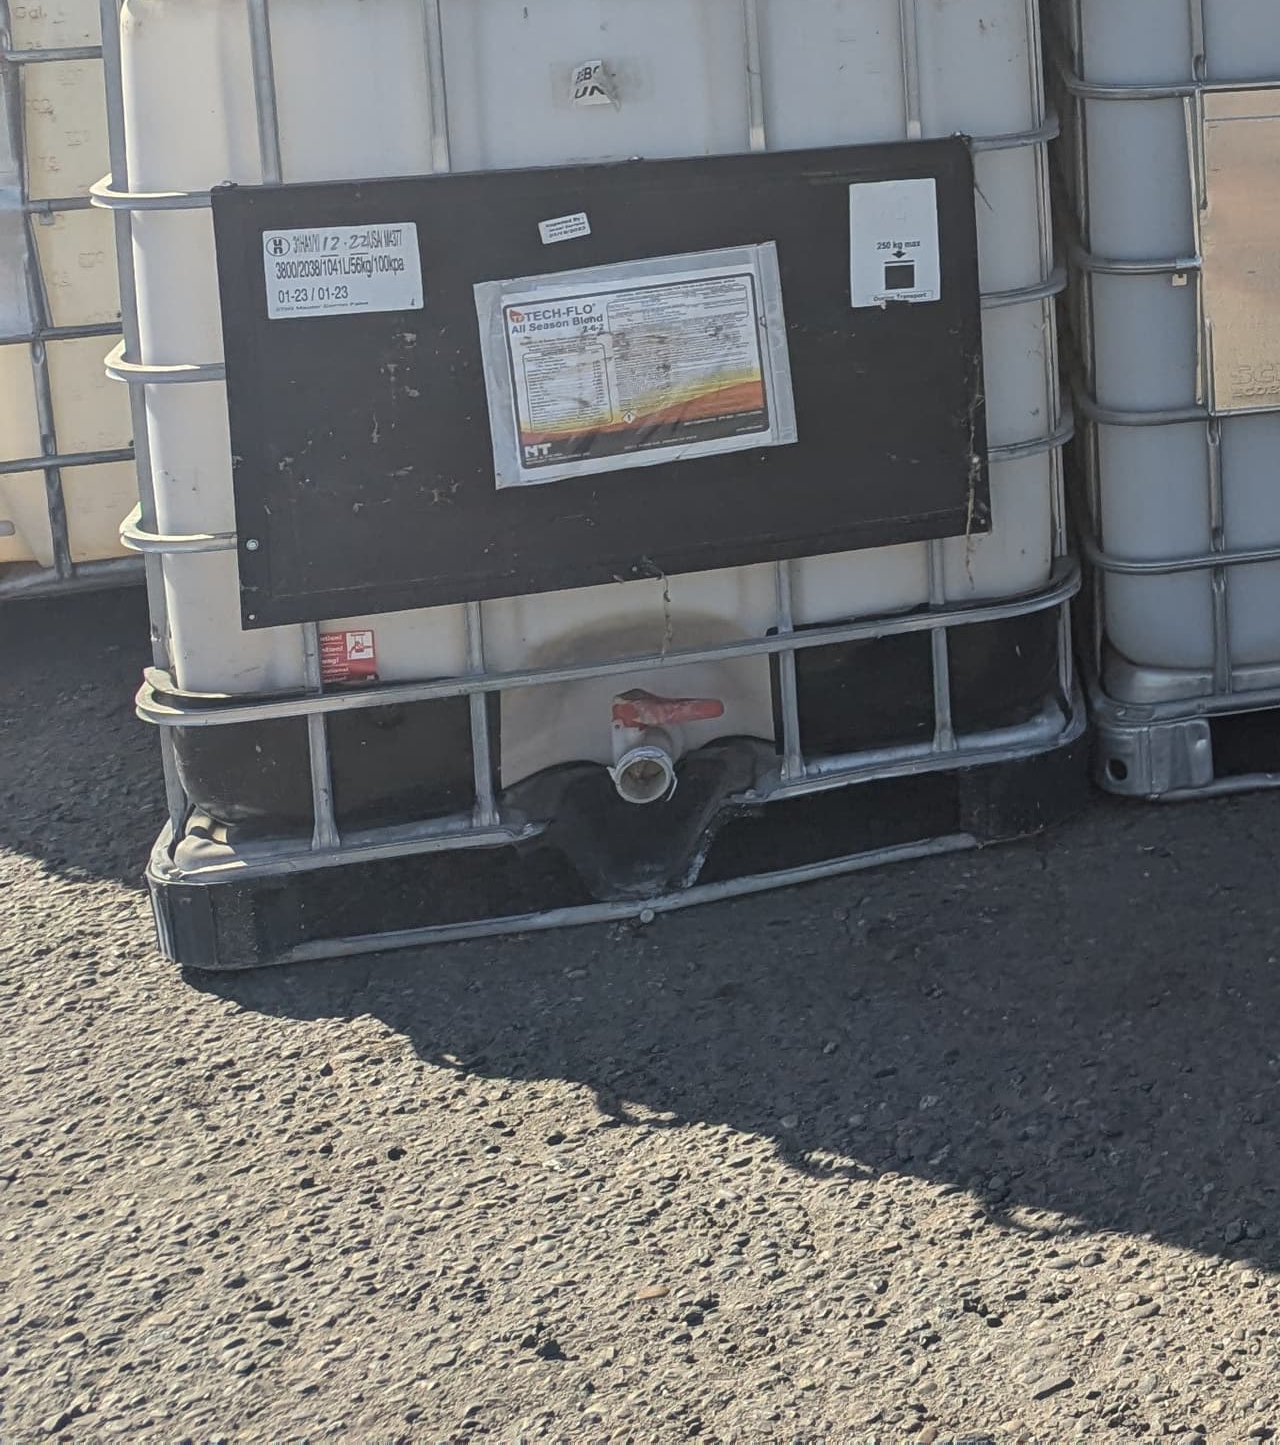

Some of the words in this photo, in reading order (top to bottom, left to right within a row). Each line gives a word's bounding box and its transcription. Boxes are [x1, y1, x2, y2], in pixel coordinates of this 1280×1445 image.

[876, 241, 892, 250] 250
[893, 240, 903, 249] kg
[904, 240, 921, 248] max
[278, 288, 308, 303] 01-23
[318, 286, 349, 300] 01-23
[511, 325, 526, 334] All
[529, 319, 569, 332] Season
[573, 314, 604, 326] Blend
